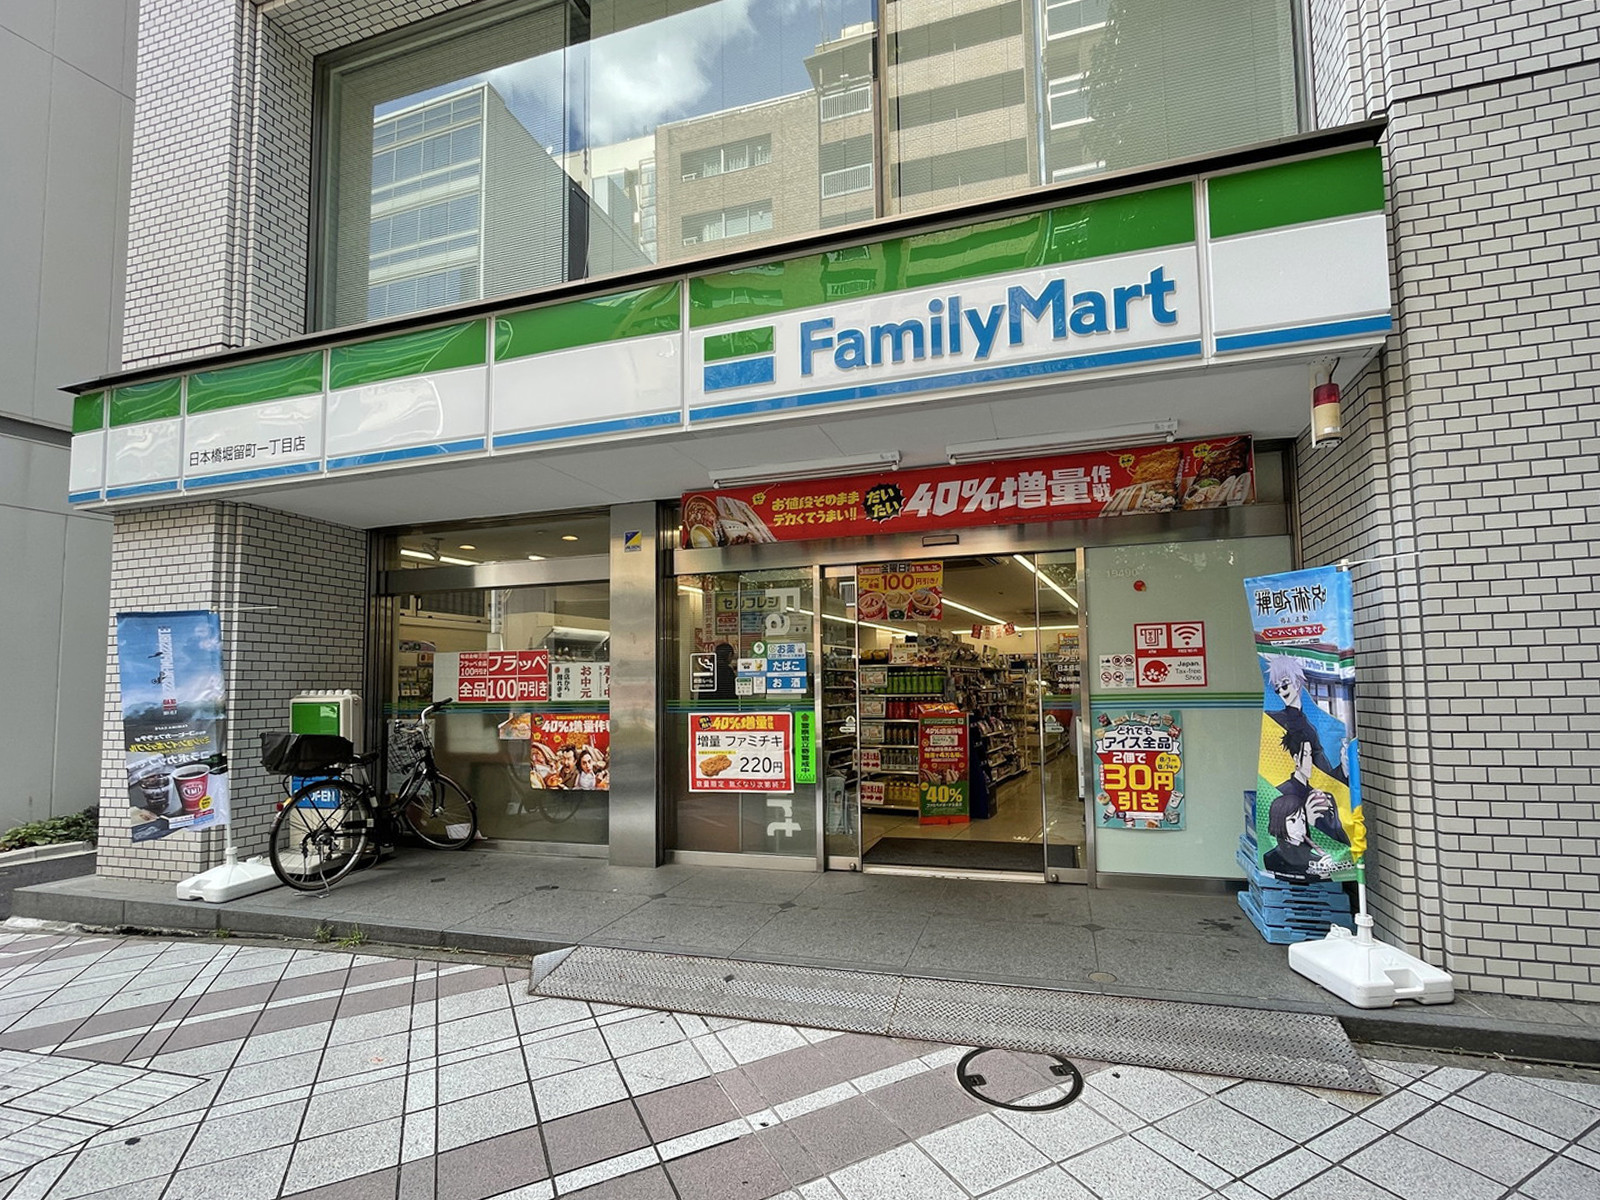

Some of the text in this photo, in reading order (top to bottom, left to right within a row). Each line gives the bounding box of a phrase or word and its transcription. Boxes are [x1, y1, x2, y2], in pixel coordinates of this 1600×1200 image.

[799, 265, 1178, 377] FamilyMart
[189, 435, 306, 467] 日本橋堀留町一丁目店
[771, 492, 860, 511] お値段そのまま
[866, 487, 894, 505] だい
[903, 469, 1092, 518] 40%増量
[871, 501, 899, 517] たい
[489, 654, 547, 672] フラッペ
[773, 661, 800, 671] たばこ
[459, 679, 547, 699] 全品100円引き
[580, 665, 592, 698] お中元
[1117, 726, 1153, 735] どれでも
[697, 735, 782, 747] 増量 ファミチキ
[1104, 736, 1171, 749] アイス全品
[739, 756, 783, 774] 220円
[1112, 752, 1147, 764] 2個で
[1104, 764, 1174, 791] 30円
[926, 785, 963, 802] 40%
[1117, 791, 1159, 811] 引き
